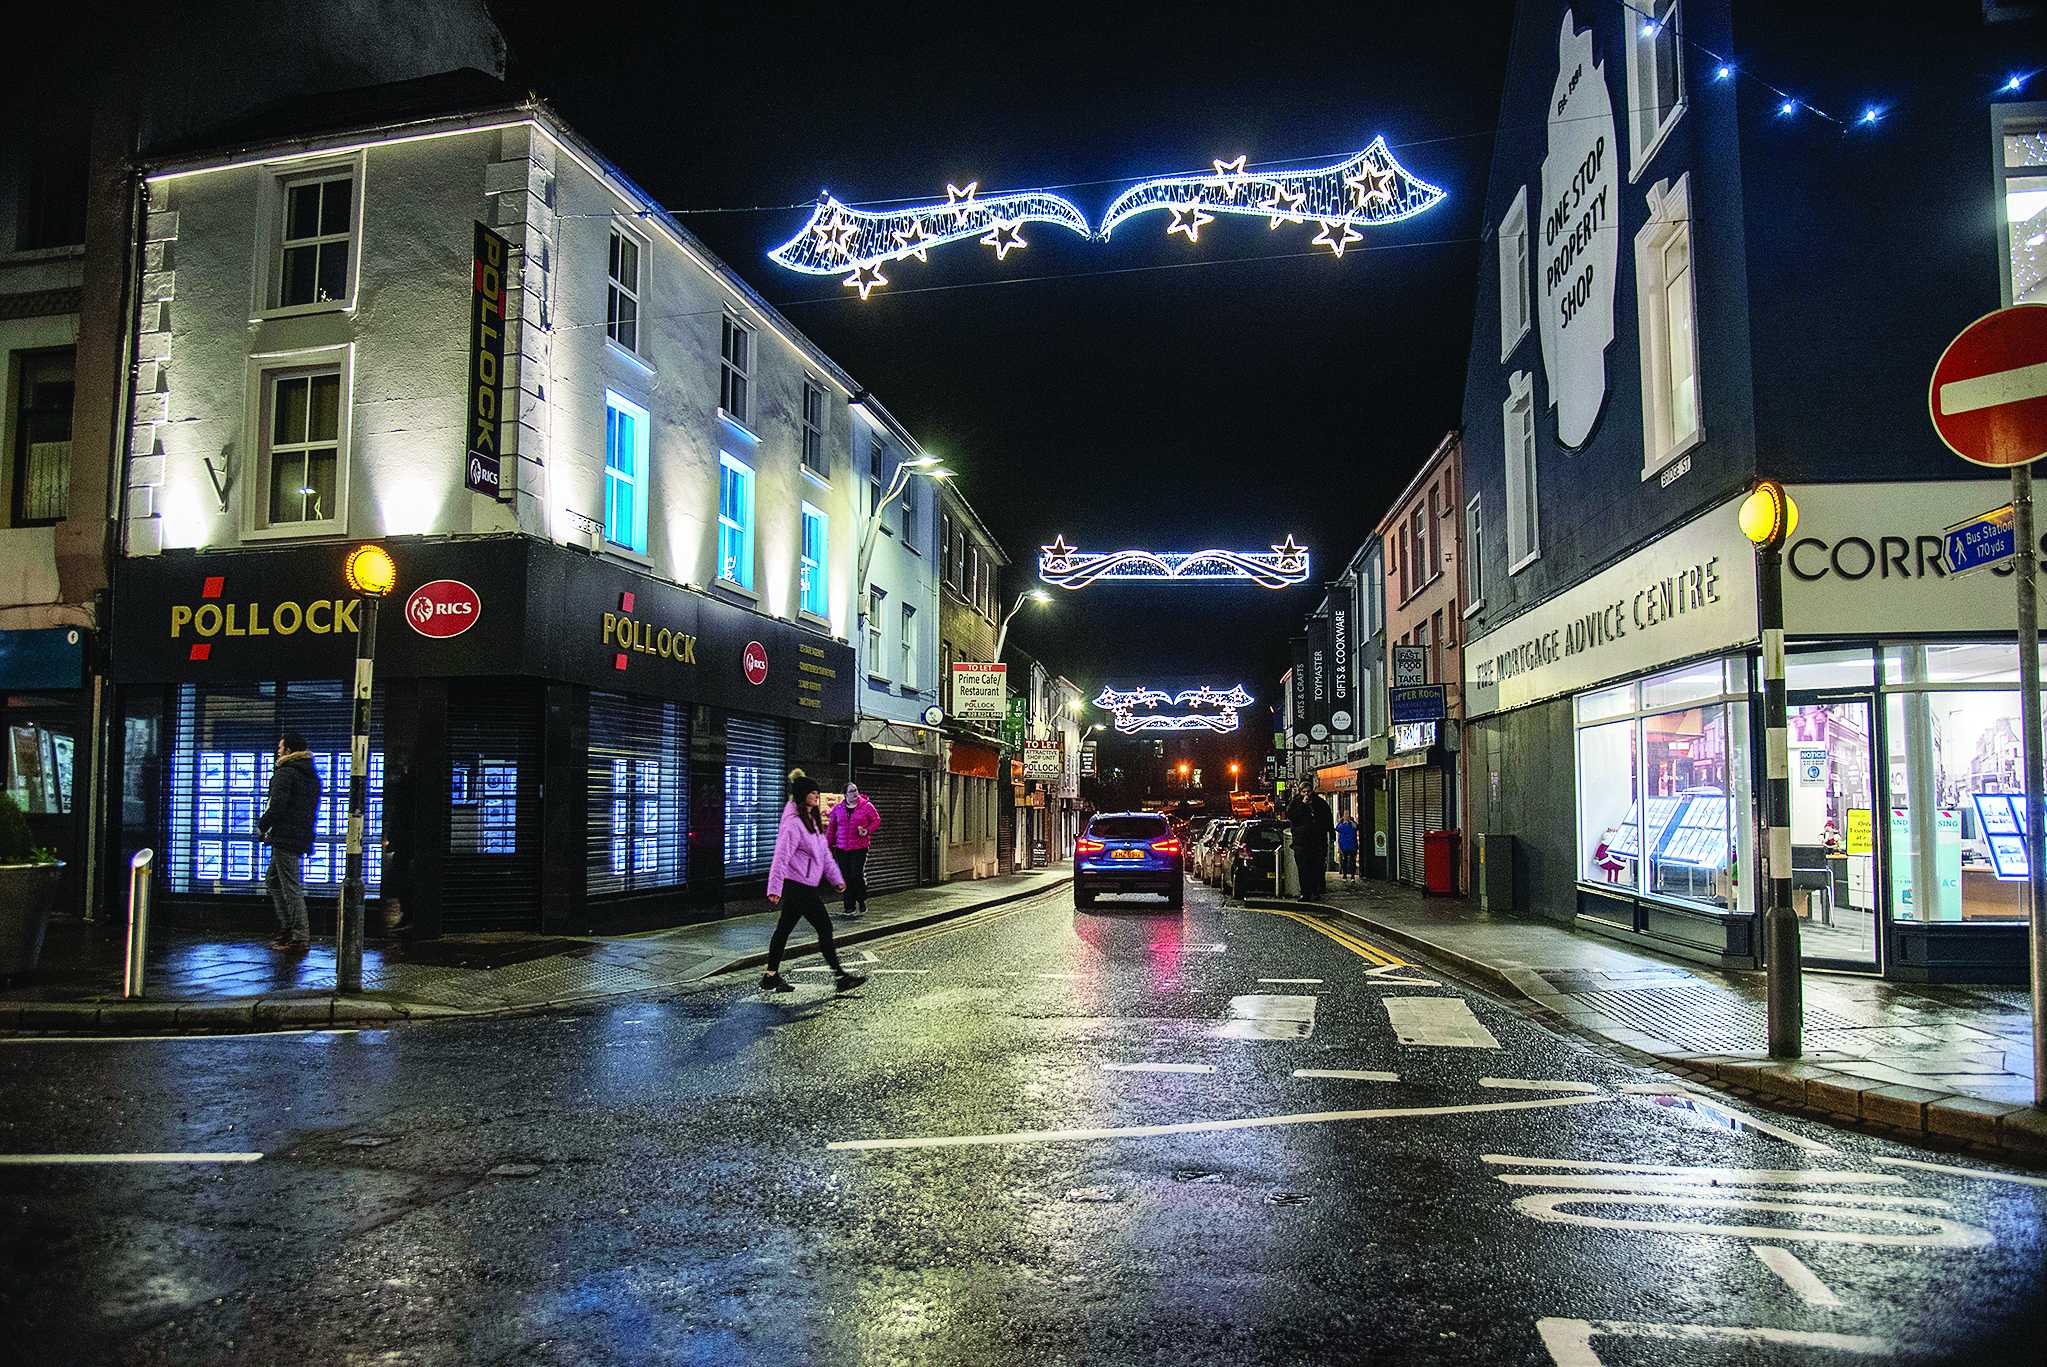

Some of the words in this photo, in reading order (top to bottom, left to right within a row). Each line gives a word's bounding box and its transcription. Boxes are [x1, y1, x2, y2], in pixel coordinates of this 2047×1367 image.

[1546, 189, 1570, 247] ONE
[1572, 135, 1605, 209] STOP
[1546, 183, 1608, 298] PROPERTY
[1560, 263, 1594, 330] SHOP
[476, 232, 501, 453] POLLOCK
[481, 468, 498, 486] RICS
[1966, 531, 1981, 545] Bus
[1982, 520, 2013, 540] Station
[1788, 536, 1947, 580] CORR
[1976, 542, 1990, 558] 170
[1990, 538, 2005, 557] yds
[171, 599, 361, 638] POLLOCK
[435, 600, 473, 616] RICS
[1475, 658, 1494, 691] THE
[1496, 628, 1560, 683] MORTGAGE
[1564, 599, 1626, 658] ADVICE
[1633, 555, 1721, 631] CENTRE
[603, 612, 697, 665] POLLOCK
[1336, 610, 1346, 664] COOKWARE
[754, 658, 766, 669] RICS
[1314, 650, 1323, 701] TOYMASTER
[1336, 664, 1346, 673] &
[958, 673, 980, 684] Prime
[981, 673, 1001, 686] Cafe/
[1297, 663, 1305, 692] CRAFTS
[1336, 673, 1346, 699] GIFTS
[960, 686, 999, 696] Restaurant
[1297, 693, 1305, 701] &
[1418, 690, 1440, 698] ROOM
[1297, 701, 1305, 720] ARTS
[1025, 741, 1039, 749] TO
[1041, 741, 1058, 749] LET
[1023, 763, 1059, 771] POLLOCK
